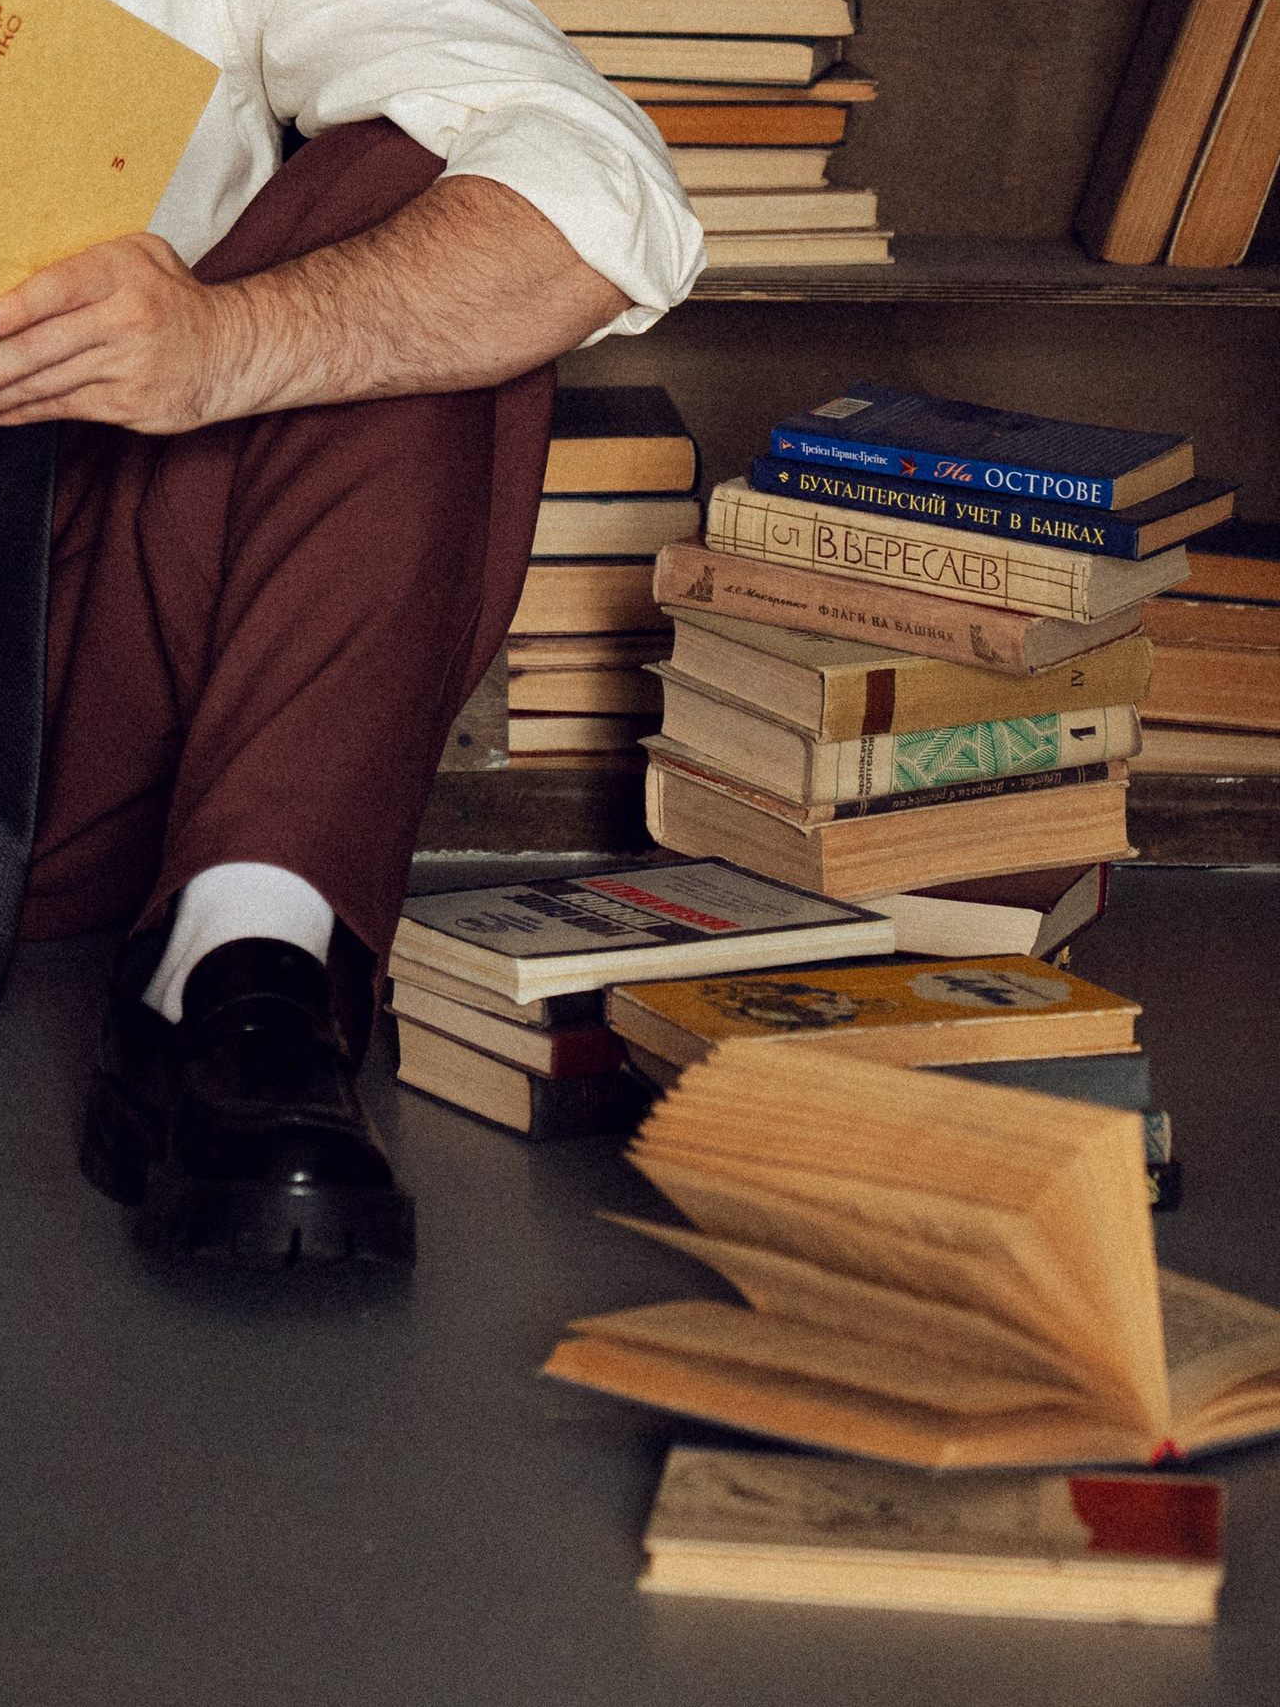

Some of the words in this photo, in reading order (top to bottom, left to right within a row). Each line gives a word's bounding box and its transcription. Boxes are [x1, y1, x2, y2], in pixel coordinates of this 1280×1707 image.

[933, 459, 973, 483] На
[985, 467, 1103, 505] ОСТРОВЕ
[799, 473, 946, 518] БУХГАЛТЕРСКИЙ
[955, 502, 1002, 527] УЧЕТ
[1009, 511, 1022, 530] В
[1030, 516, 1107, 547] БАНКАХ
[818, 604, 867, 625] ФЛАГИ
[871, 615, 889, 631] НА
[894, 620, 956, 644] БАШНЯХ
[1069, 724, 1097, 742] 1
[552, 890, 674, 929] THROUGH
